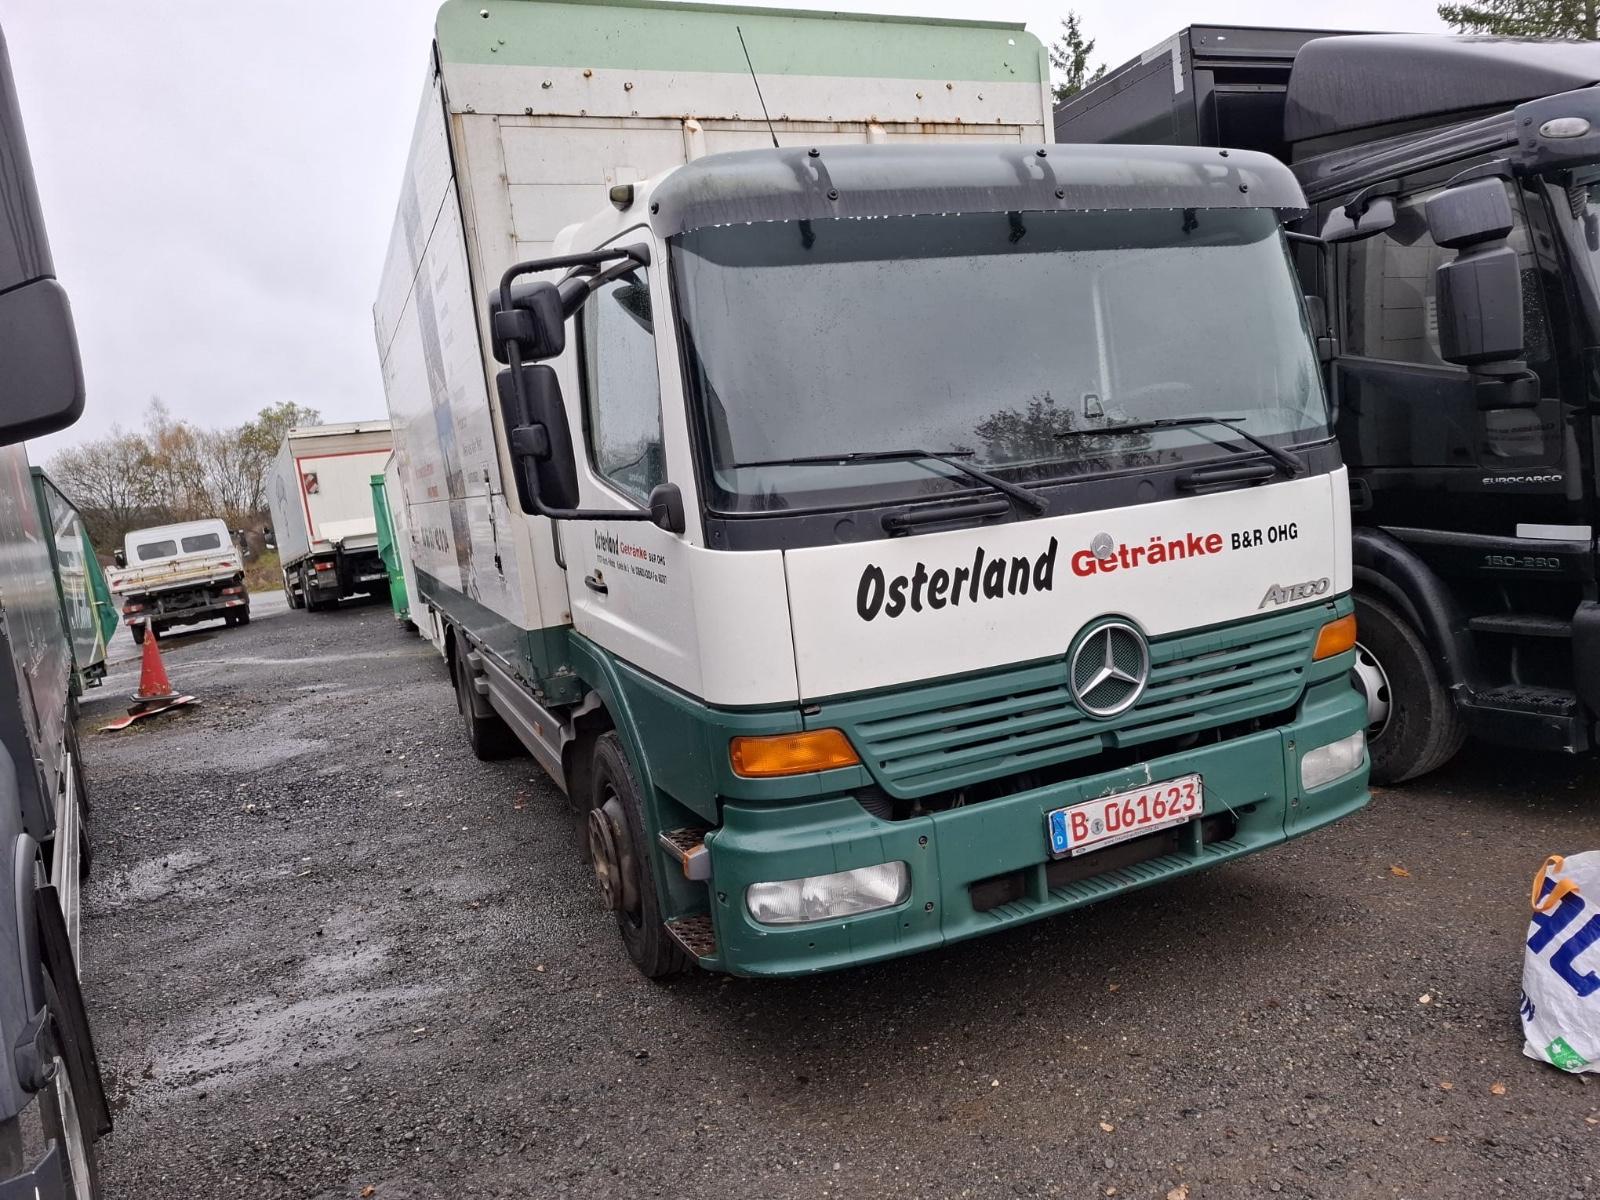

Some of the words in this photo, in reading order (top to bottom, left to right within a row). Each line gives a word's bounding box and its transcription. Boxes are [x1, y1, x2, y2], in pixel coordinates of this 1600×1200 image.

[1482, 474, 1562, 485] EUROCARGO
[856, 536, 1058, 622] Osterland
[1070, 532, 1223, 577] Getränke
[1231, 530, 1263, 550] B&R
[1268, 522, 1299, 543] OHG
[1071, 811, 1088, 842] B
[1104, 783, 1196, 832] 061623
[1057, 836, 1063, 845] D
